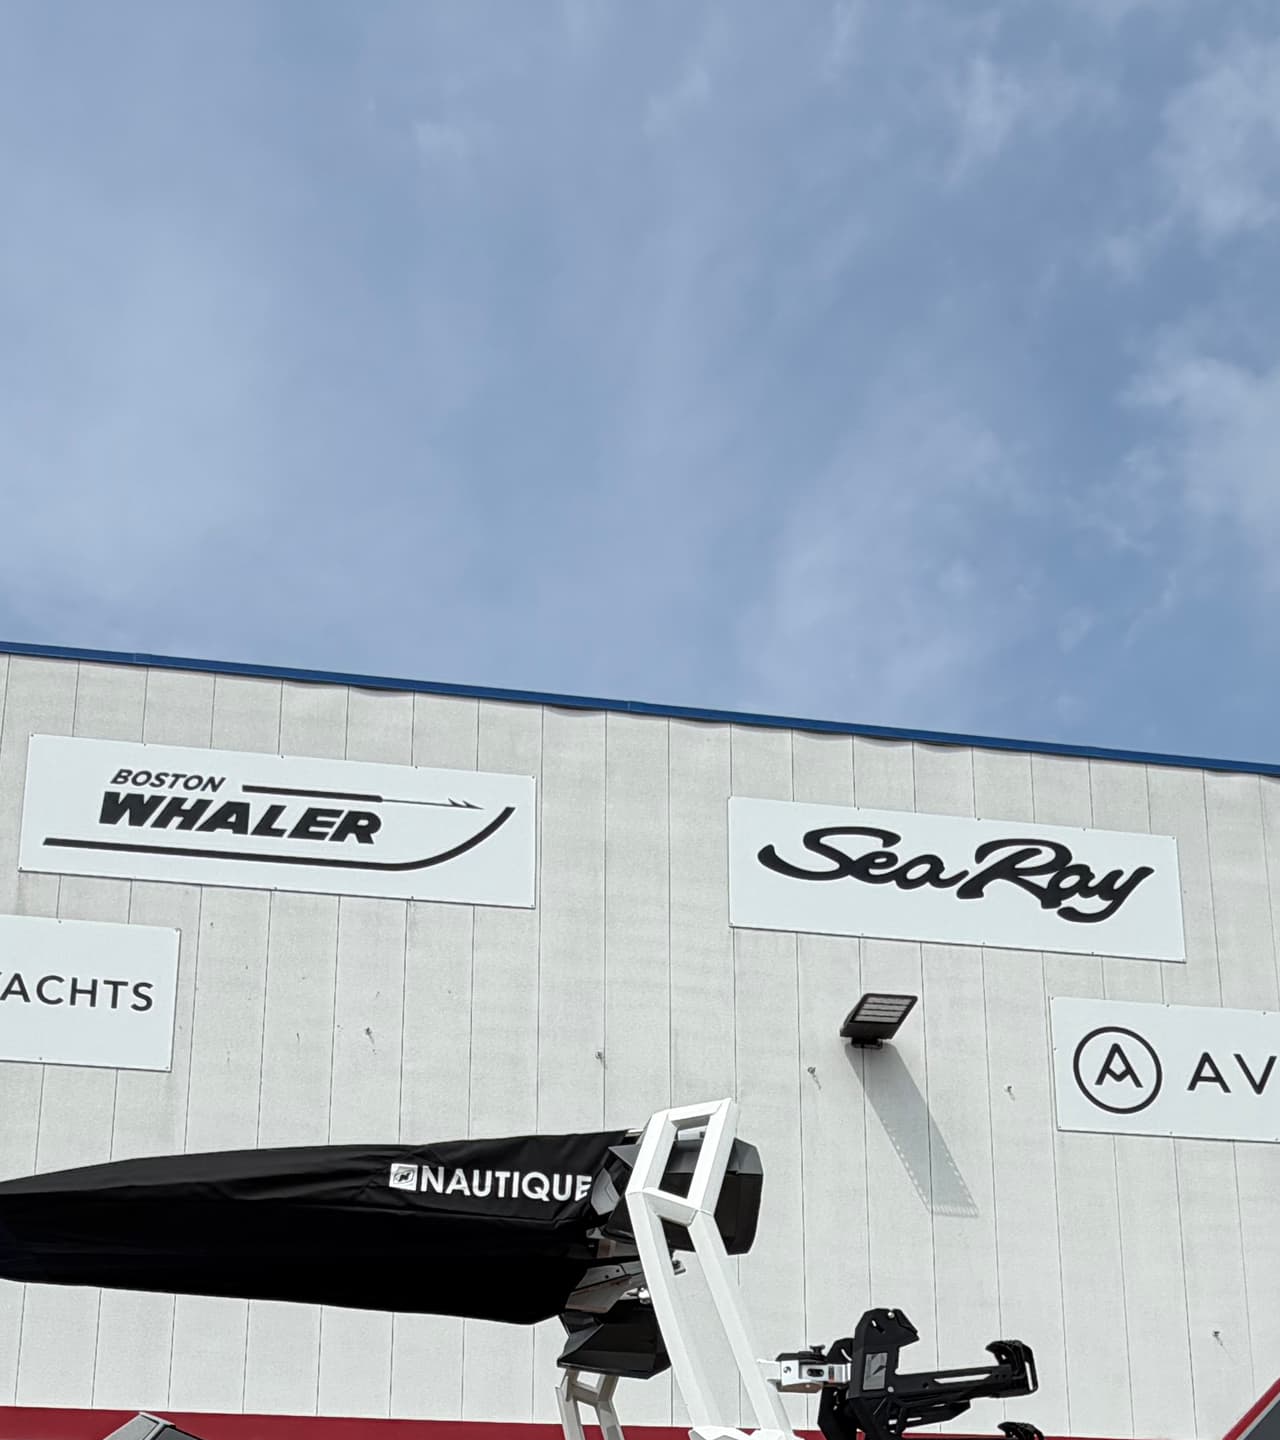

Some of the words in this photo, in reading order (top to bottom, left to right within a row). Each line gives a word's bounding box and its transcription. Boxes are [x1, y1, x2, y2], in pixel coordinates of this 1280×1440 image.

[110, 768, 227, 793] BOSTON
[98, 791, 382, 845] WHALER
[757, 826, 970, 890] Sea
[956, 838, 1155, 924] Ray
[420, 1165, 593, 1202] NAUTIQUE
